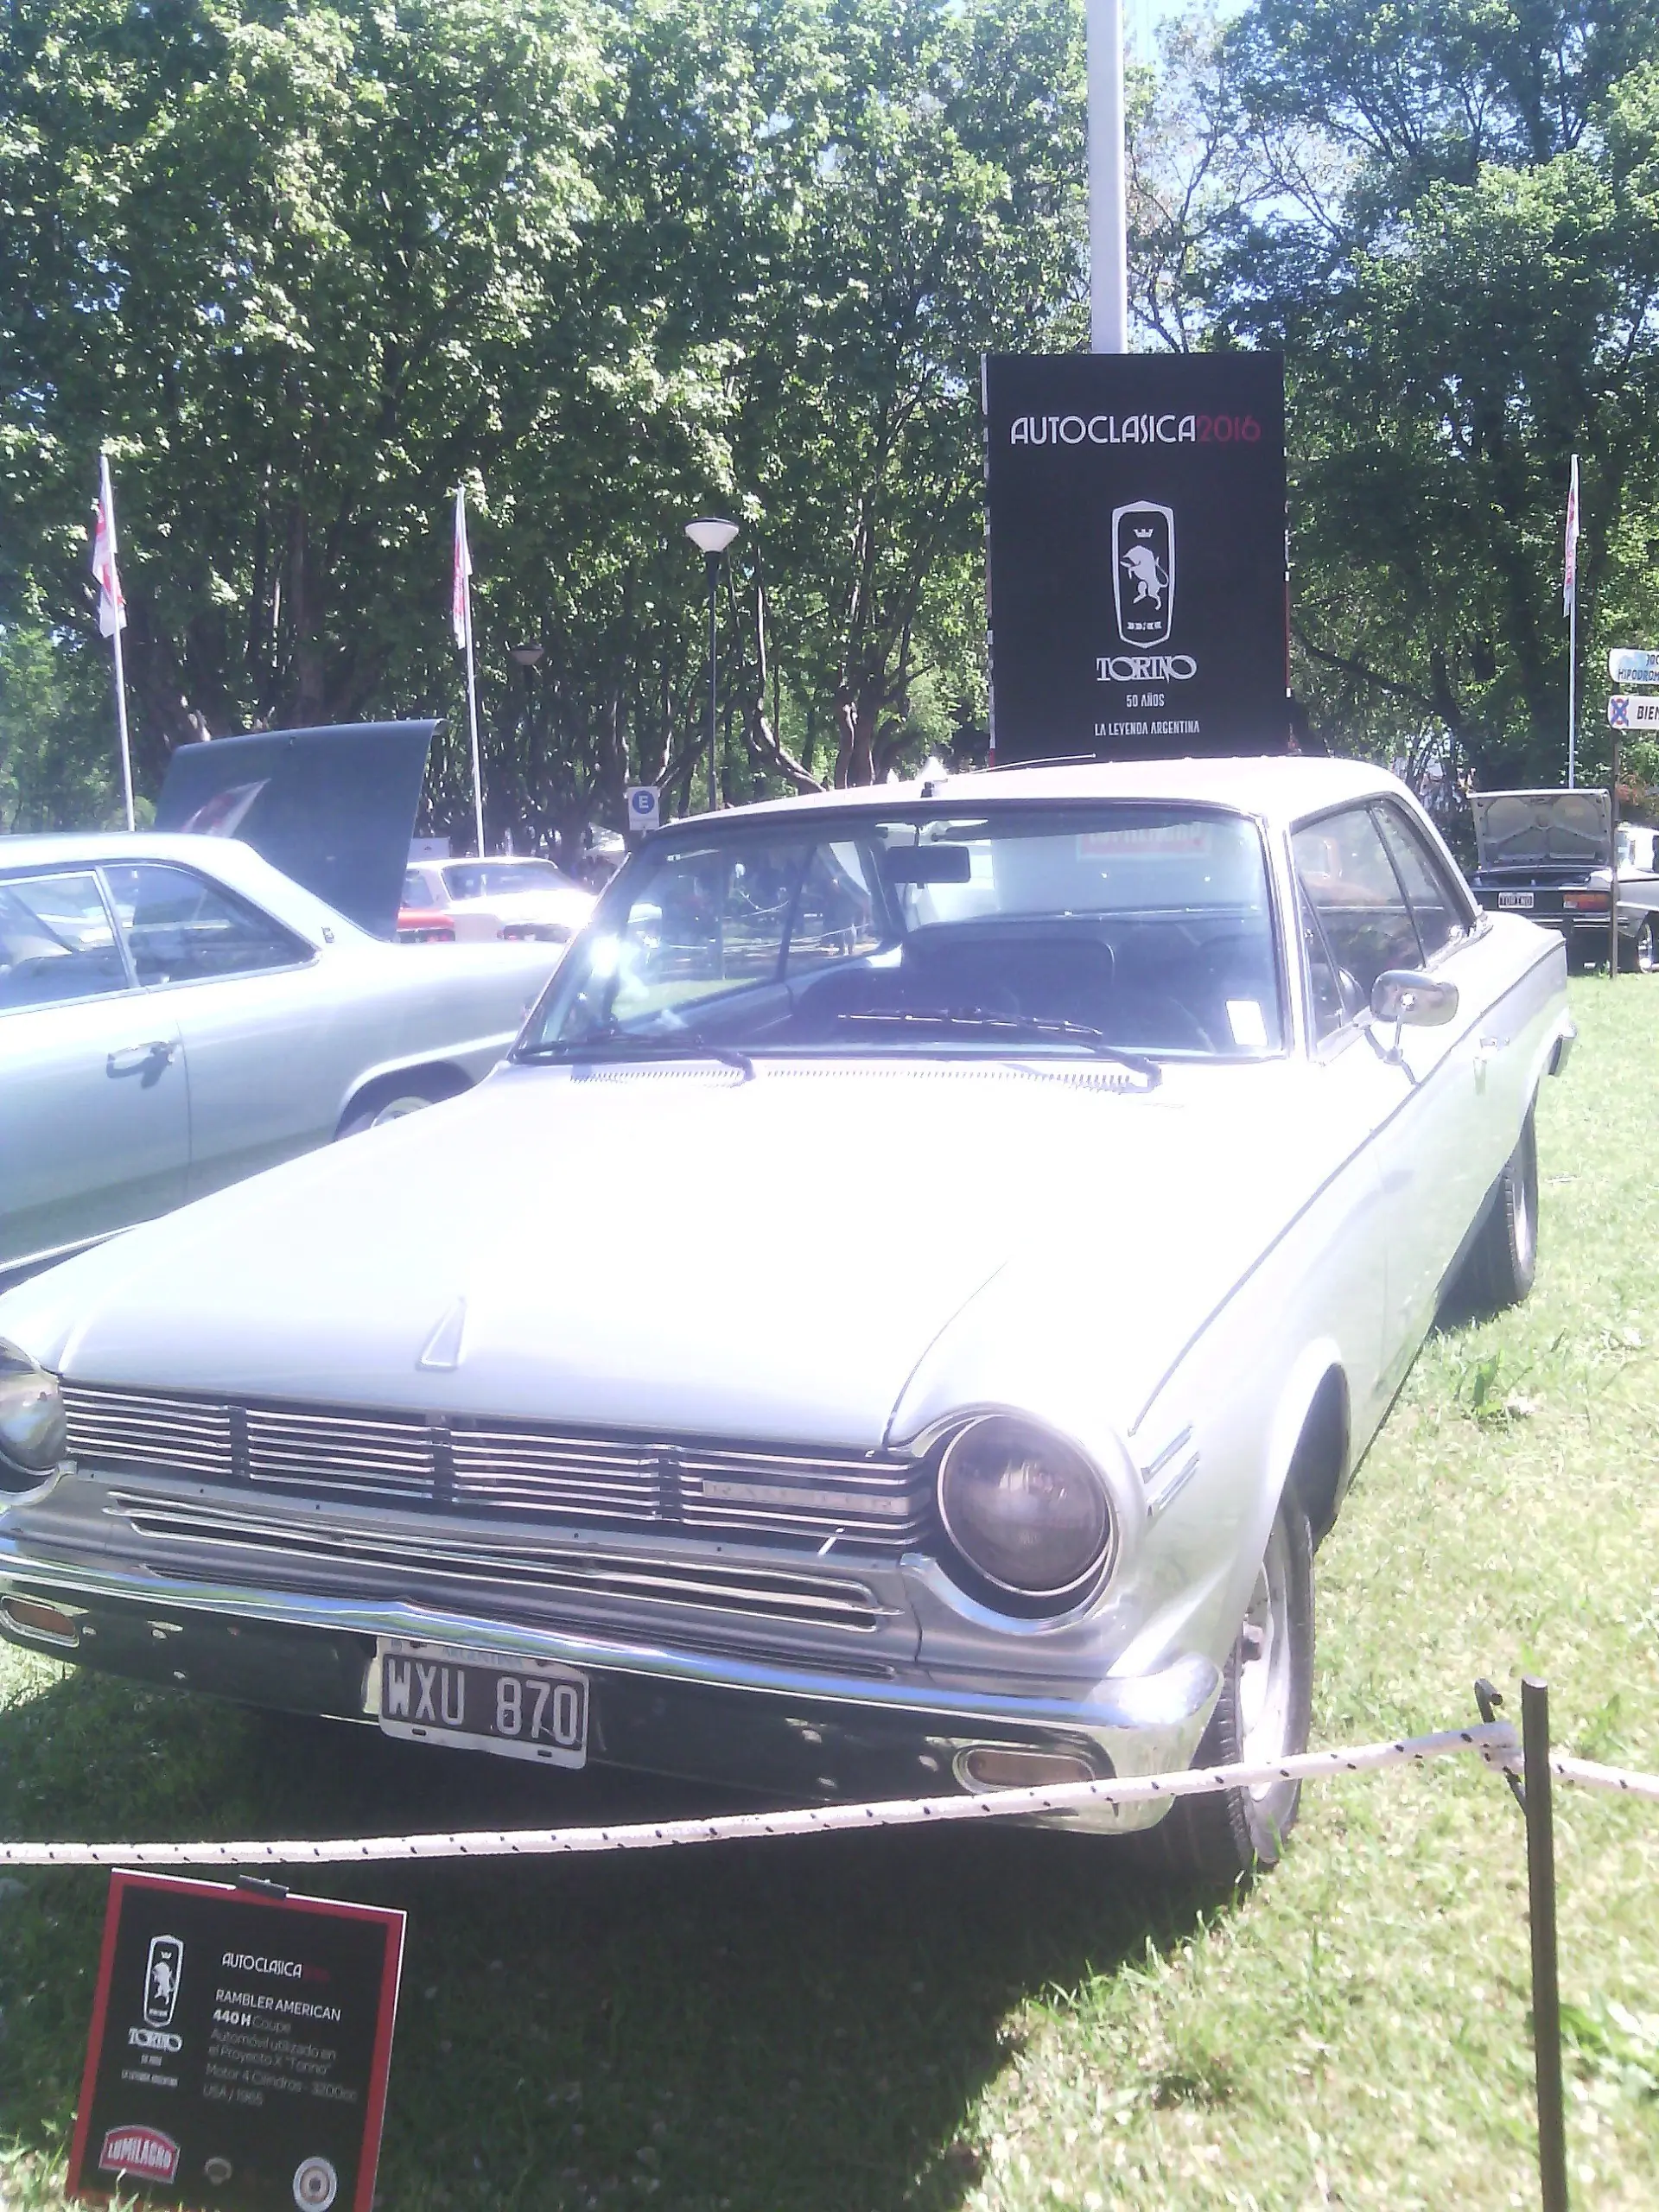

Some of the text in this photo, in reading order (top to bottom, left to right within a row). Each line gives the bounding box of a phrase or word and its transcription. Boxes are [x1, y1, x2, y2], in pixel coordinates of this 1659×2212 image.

[1096, 655, 1198, 683] TORINO
[1126, 692, 1165, 708] 50 AÑOS
[1095, 720, 1200, 736] LA LEYENDA ARGENTINA
[639, 795, 649, 809] E
[388, 1657, 579, 1745] WXU 870
[216, 1988, 342, 2022] RAMBLER AMERICAN
